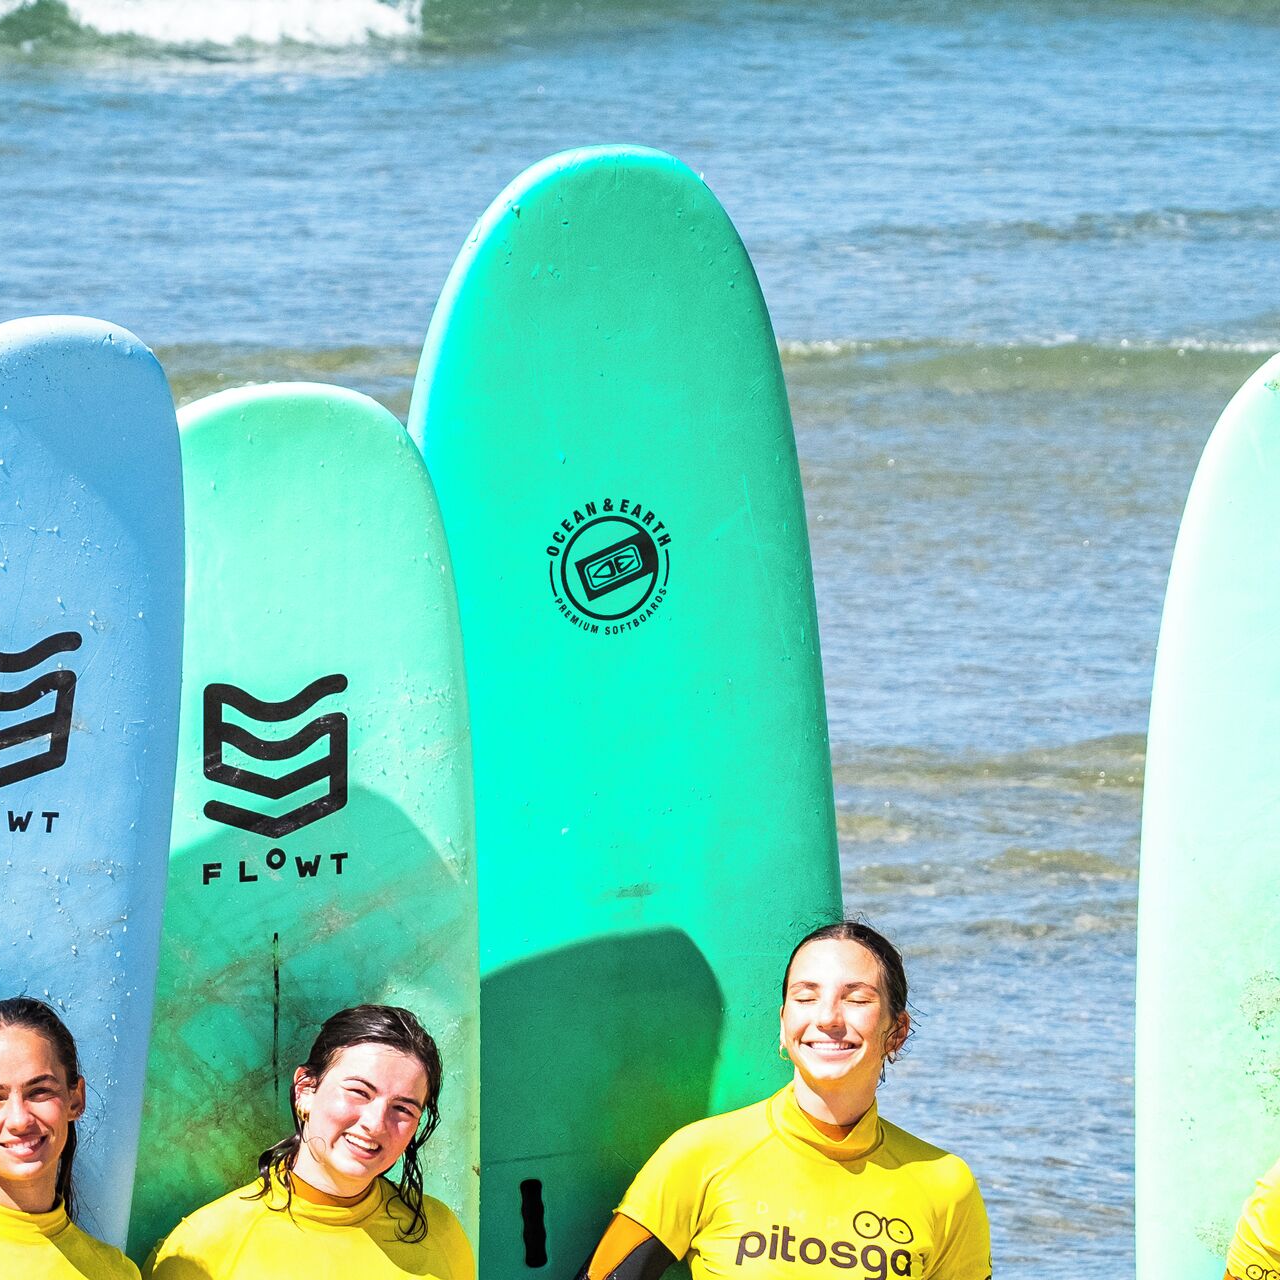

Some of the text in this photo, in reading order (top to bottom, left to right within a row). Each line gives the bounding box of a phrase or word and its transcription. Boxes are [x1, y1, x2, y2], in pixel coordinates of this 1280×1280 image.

[546, 501, 598, 557] OCEAN
[619, 499, 672, 548] EARTH
[555, 588, 667, 636] PREMIUM SOFTBOARDS
[202, 847, 349, 886] FLOWT
